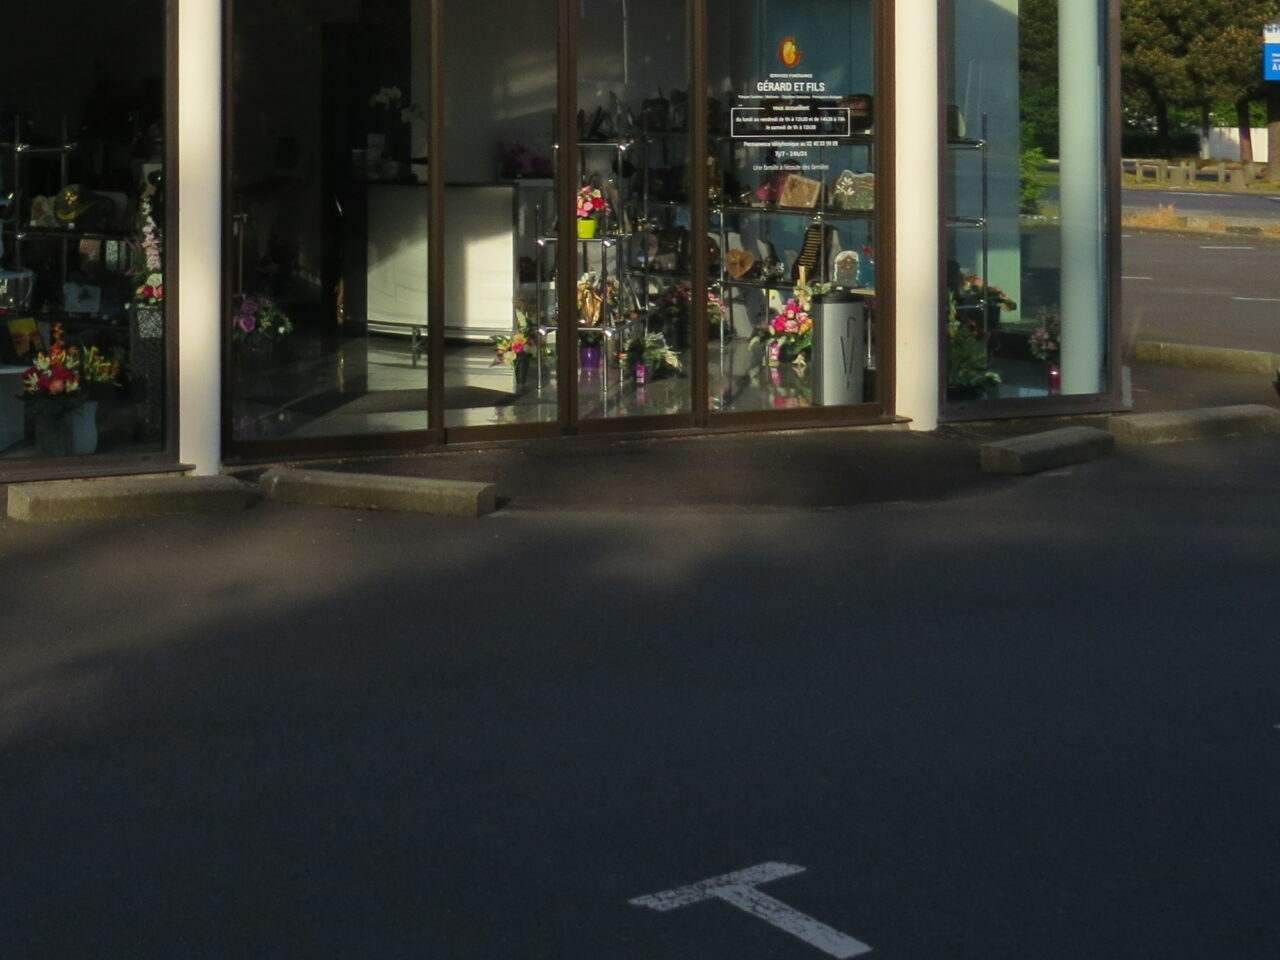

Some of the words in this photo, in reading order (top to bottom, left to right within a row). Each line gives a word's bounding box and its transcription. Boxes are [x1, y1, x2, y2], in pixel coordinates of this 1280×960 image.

[757, 79, 792, 92] GÉRARD
[794, 82, 805, 92] ET
[806, 82, 826, 92] FILS
